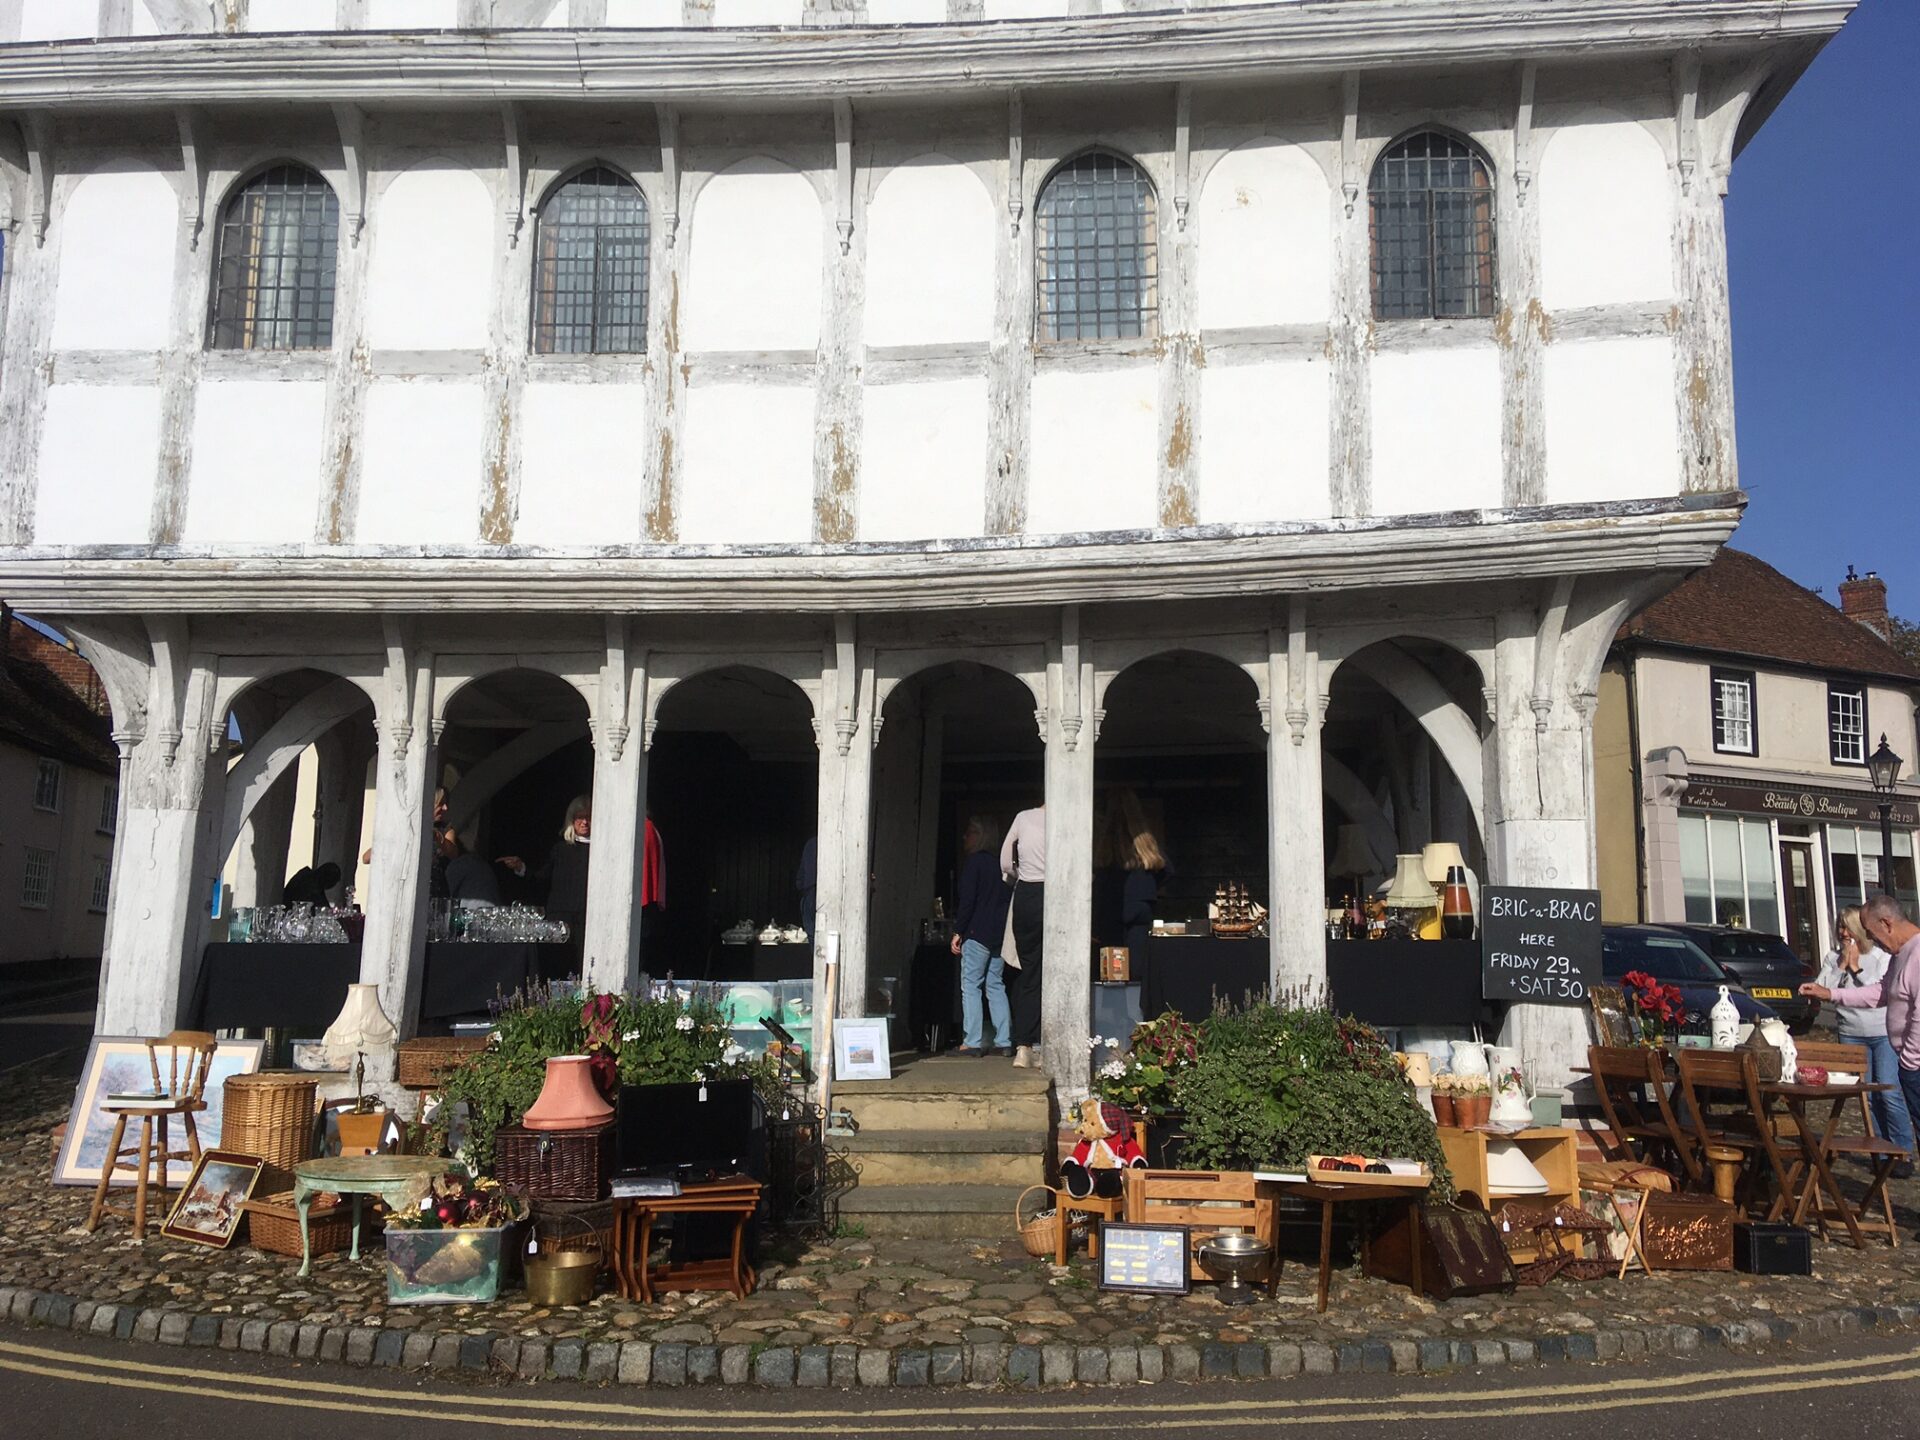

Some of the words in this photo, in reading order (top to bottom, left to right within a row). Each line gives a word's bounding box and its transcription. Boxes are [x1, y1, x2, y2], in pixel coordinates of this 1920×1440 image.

[1762, 792, 1798, 815] Beauty
[1816, 797, 1858, 819] Boutique
[1490, 896, 1596, 922] BRIC-a-BRAC
[1519, 932, 1555, 947] HERE
[1490, 952, 1540, 970] FRIDAY
[1518, 975, 1555, 996] SAT
[1557, 977, 1583, 999] 30
